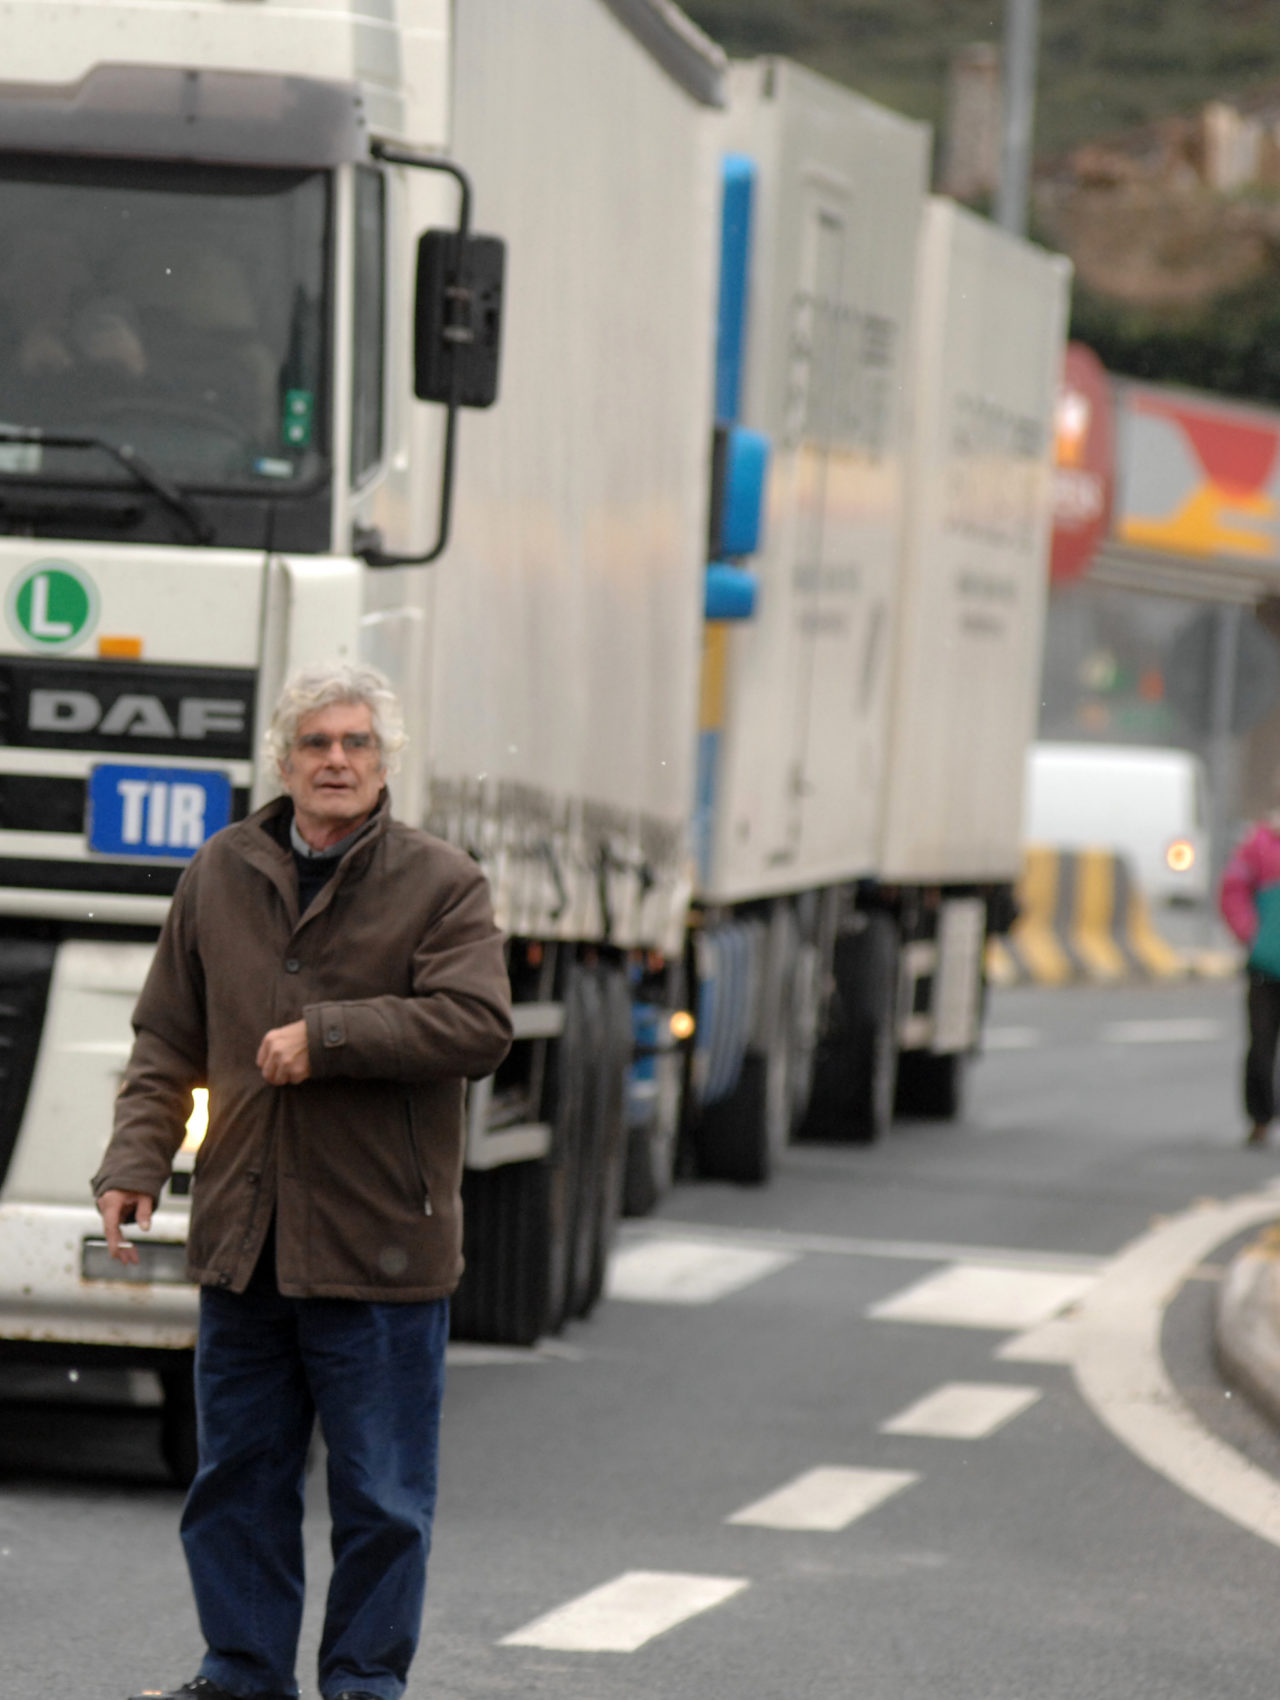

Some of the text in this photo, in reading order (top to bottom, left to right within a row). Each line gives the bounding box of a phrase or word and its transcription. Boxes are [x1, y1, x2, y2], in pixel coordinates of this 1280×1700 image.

[31, 576, 72, 636] L
[28, 690, 245, 738] DAF
[117, 780, 207, 847] TIR
